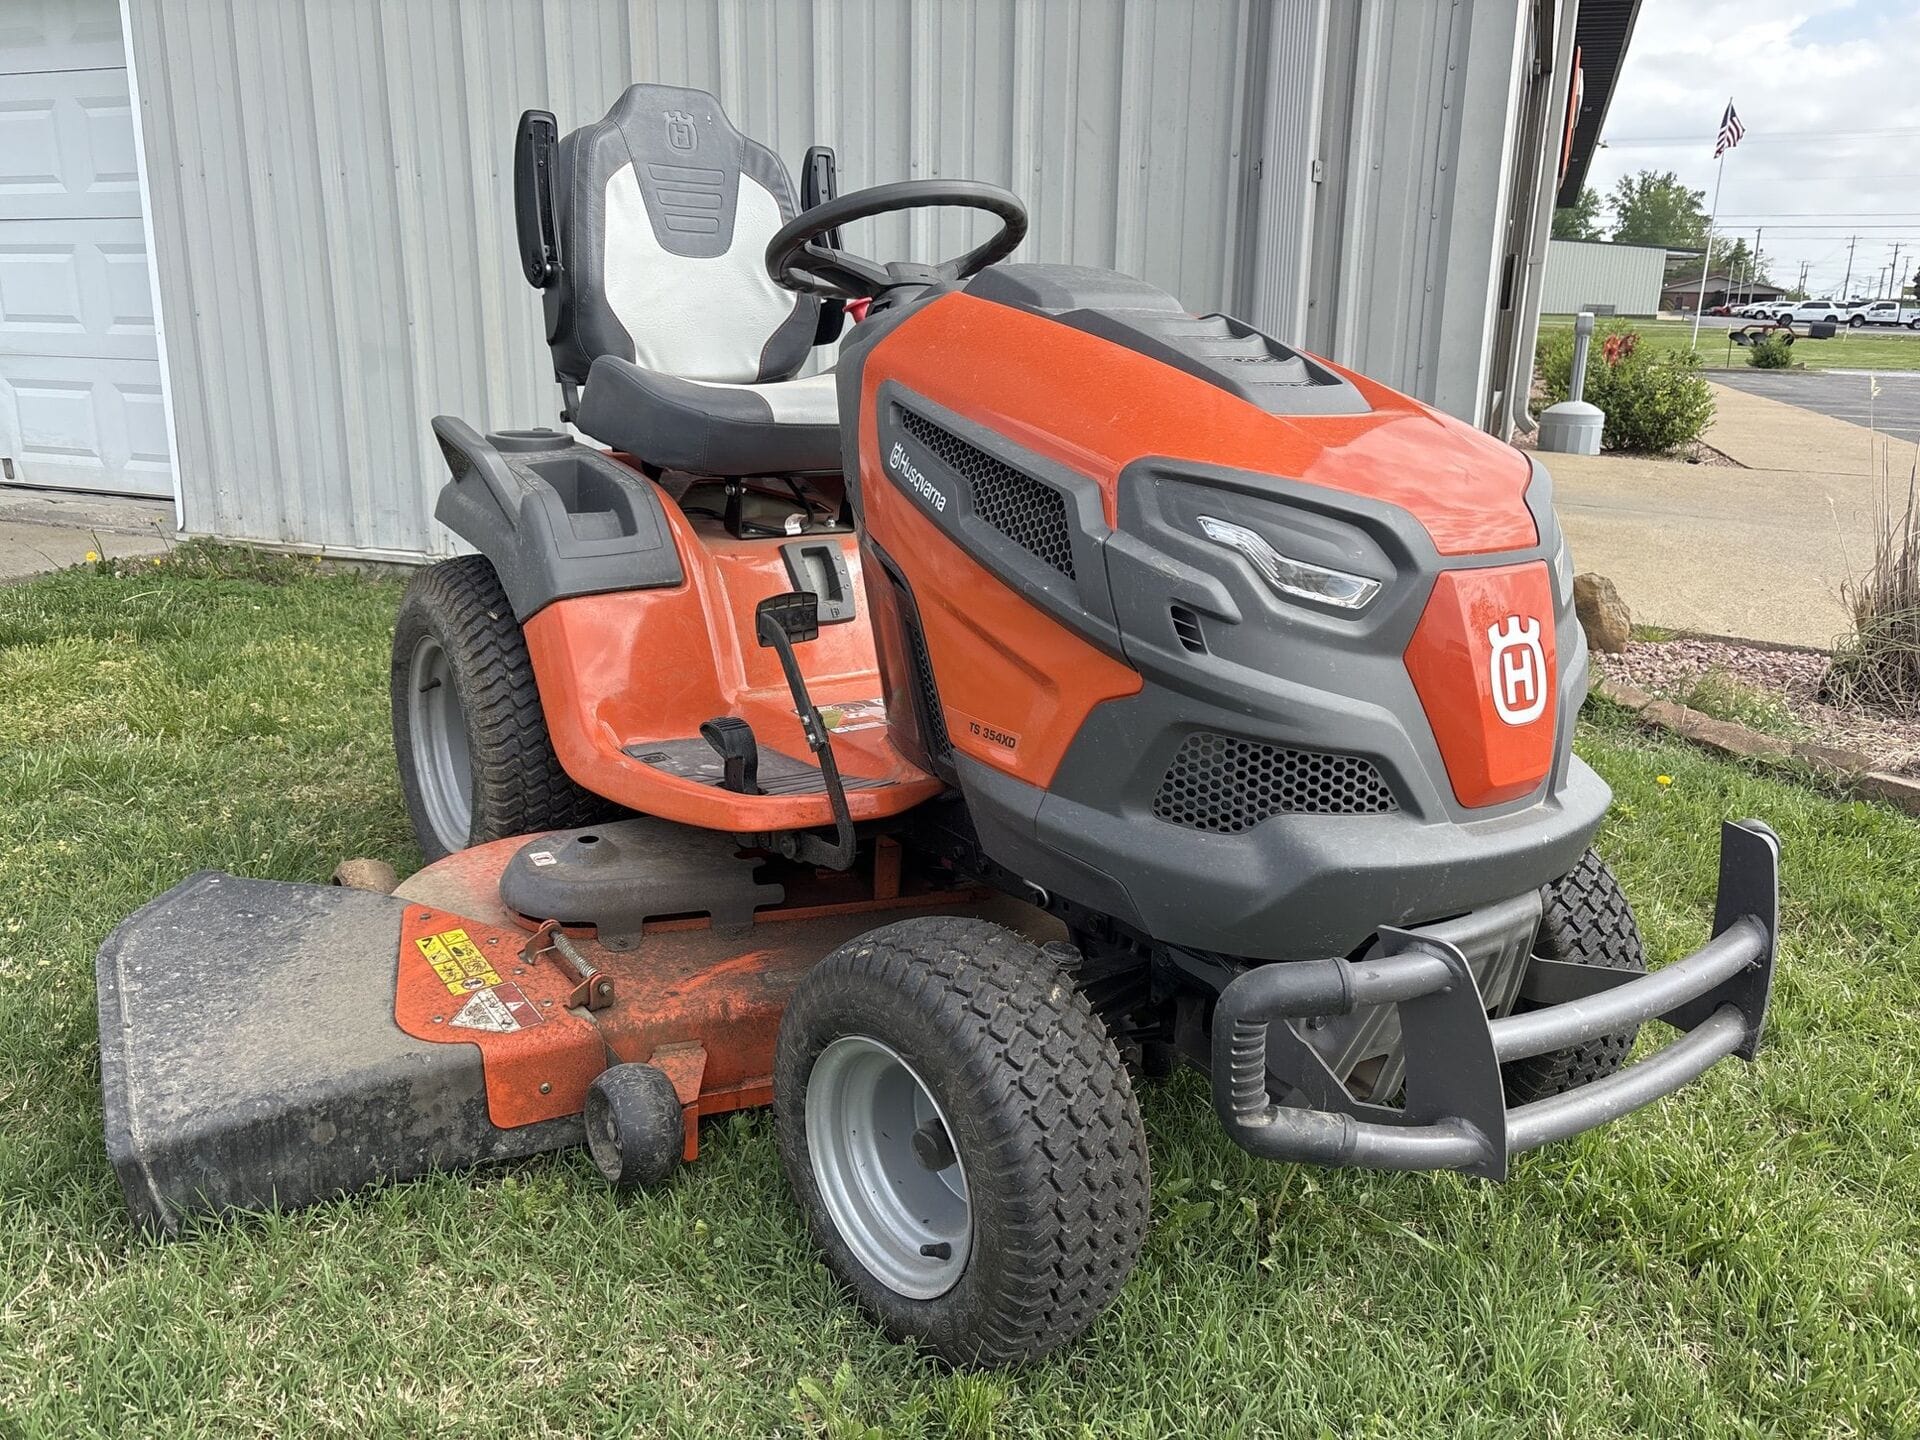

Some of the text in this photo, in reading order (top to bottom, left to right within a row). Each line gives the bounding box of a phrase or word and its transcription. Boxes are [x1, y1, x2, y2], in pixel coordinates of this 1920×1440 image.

[898, 452, 947, 512] Husqvarna
[969, 721, 1016, 749] TS 354XD
